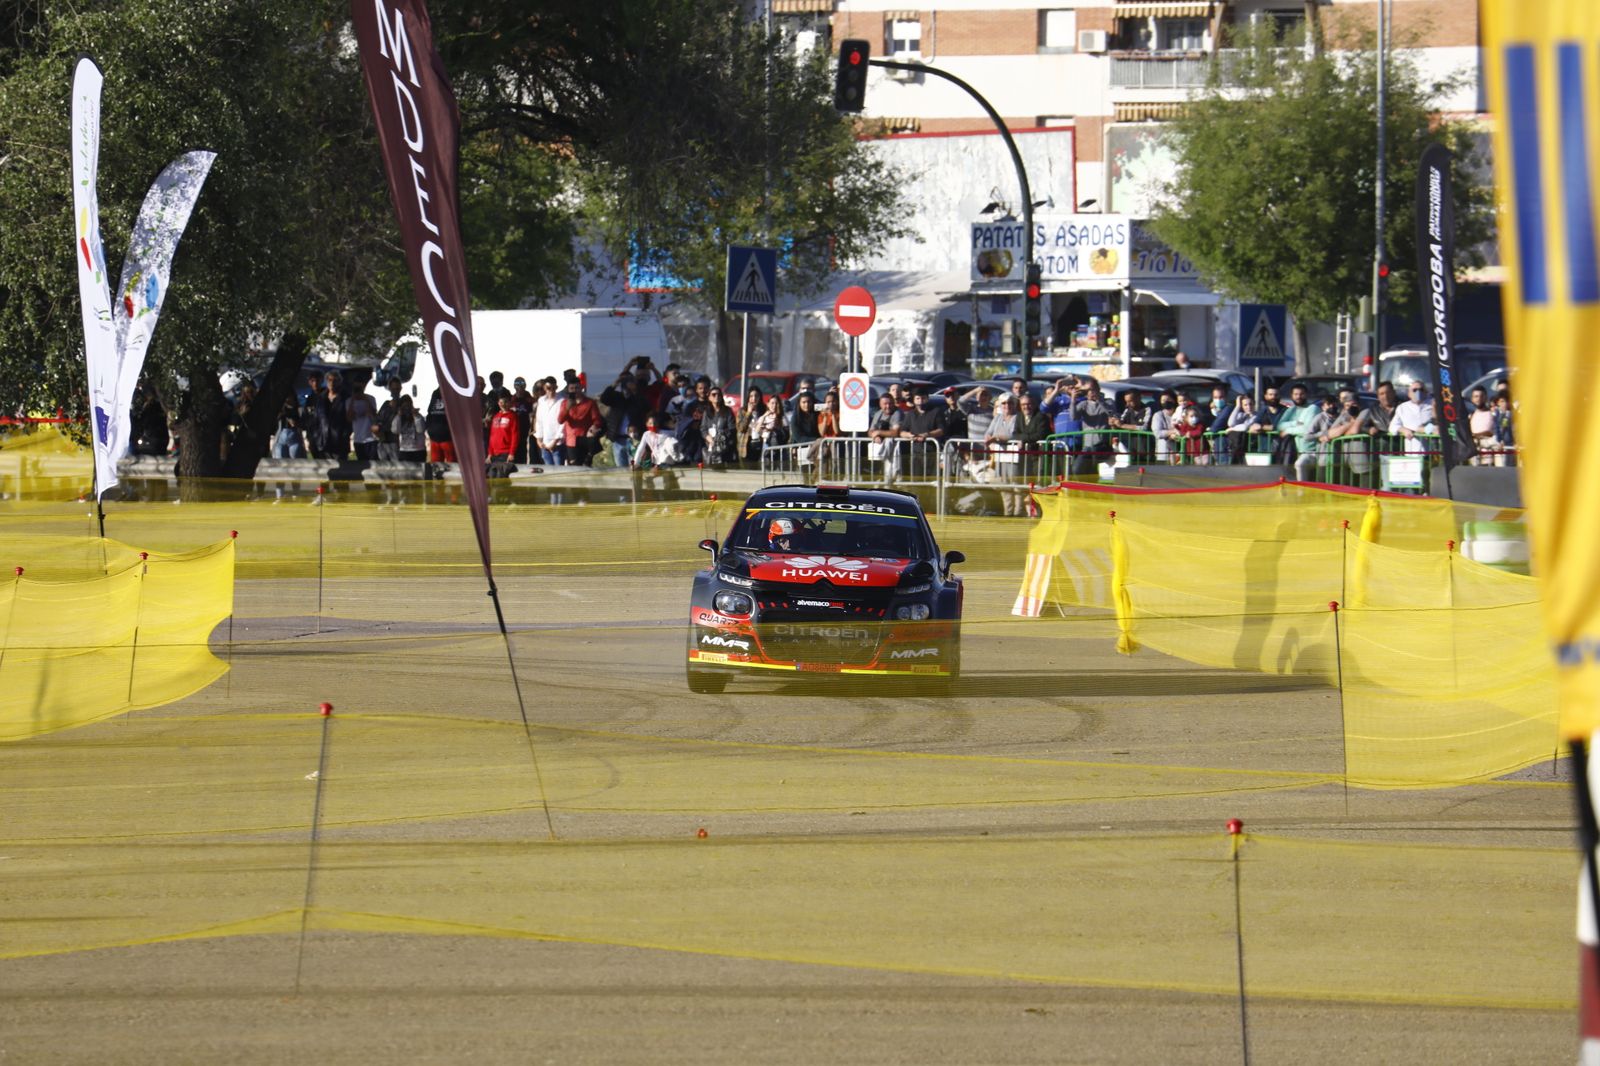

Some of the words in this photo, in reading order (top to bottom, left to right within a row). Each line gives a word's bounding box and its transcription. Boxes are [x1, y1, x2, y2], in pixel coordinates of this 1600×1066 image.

[973, 225, 1046, 248] PATATS
[1055, 224, 1125, 247] ASADAS
[782, 569, 868, 582] HUAWEI
[701, 634, 750, 650] MMR
[890, 648, 939, 660] MMR
